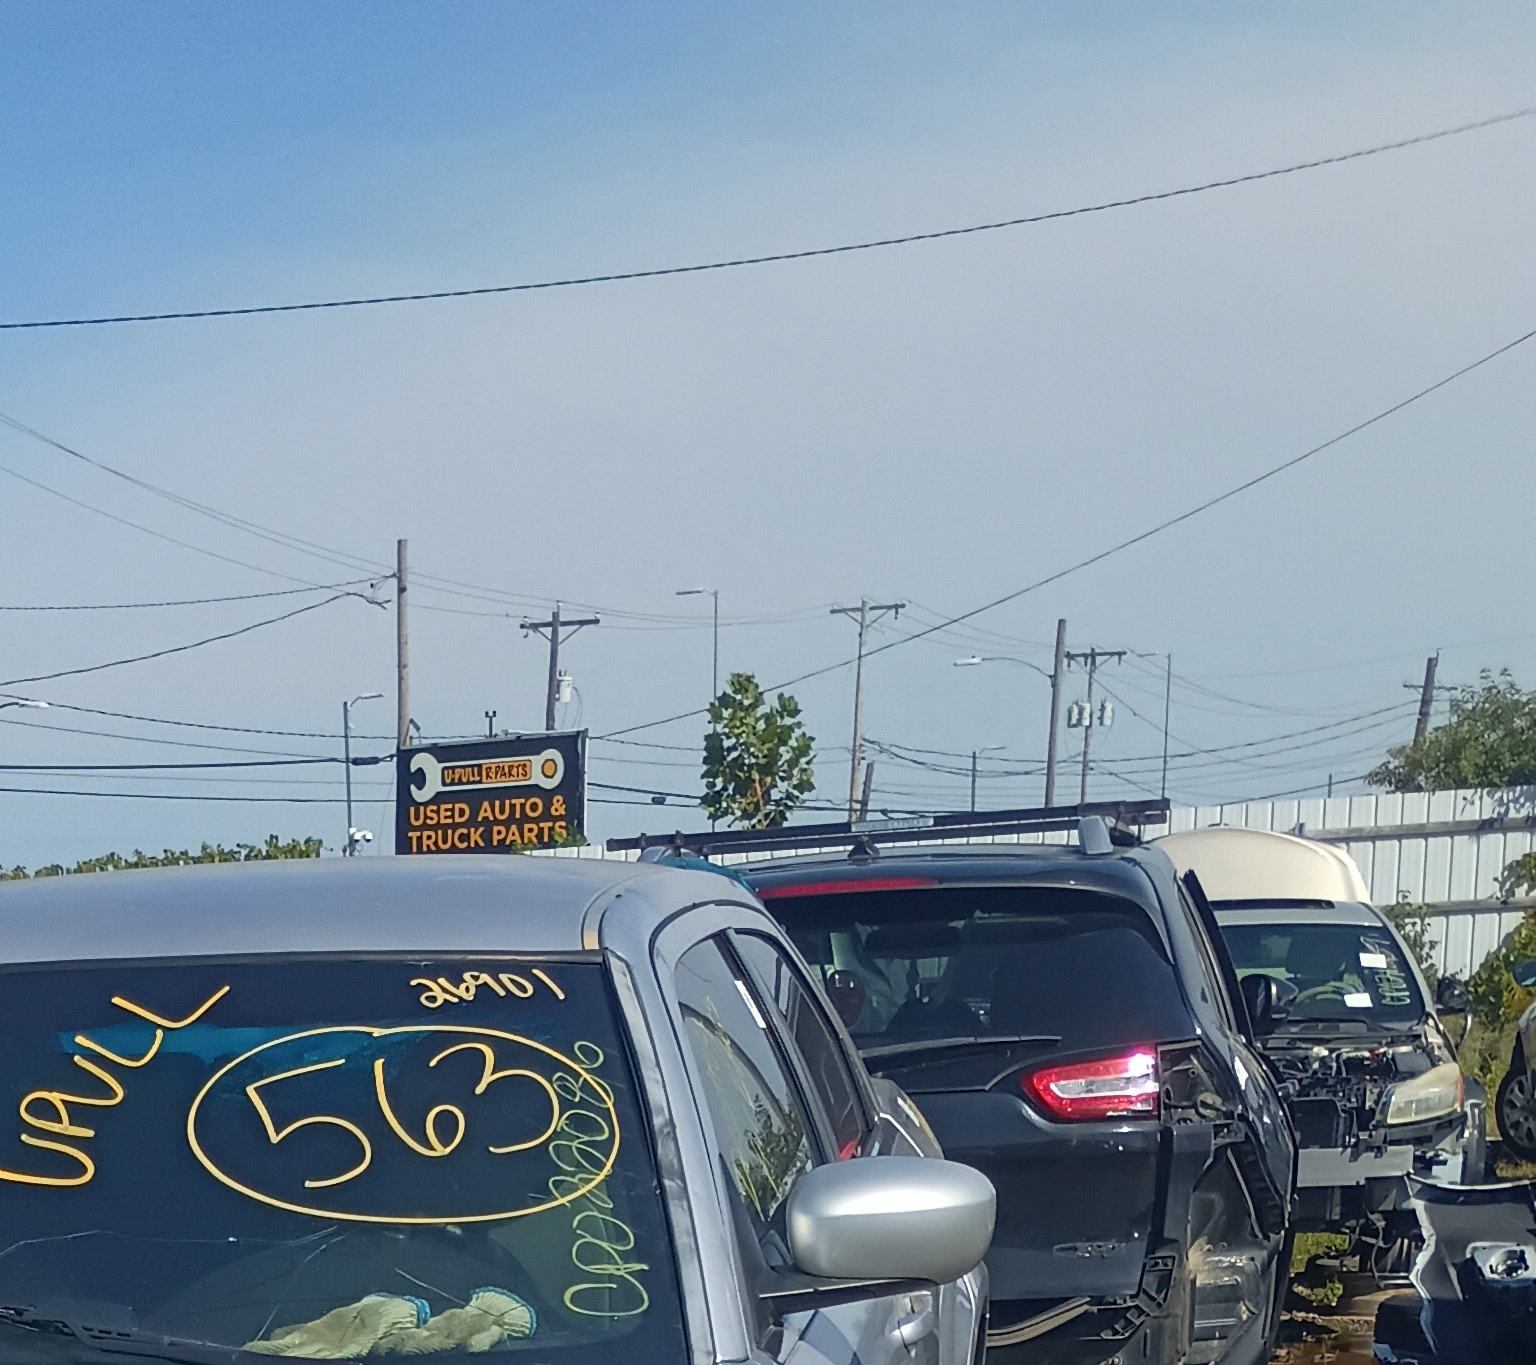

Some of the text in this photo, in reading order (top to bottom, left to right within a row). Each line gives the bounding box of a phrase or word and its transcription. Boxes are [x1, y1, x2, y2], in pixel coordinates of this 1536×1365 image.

[444, 766, 480, 784] U-PULL
[409, 795, 566, 826] USED AUTO &
[408, 821, 567, 854] TRUCK PARTS
[409, 968, 566, 1009] 26901
[245, 1041, 561, 1188] 563
